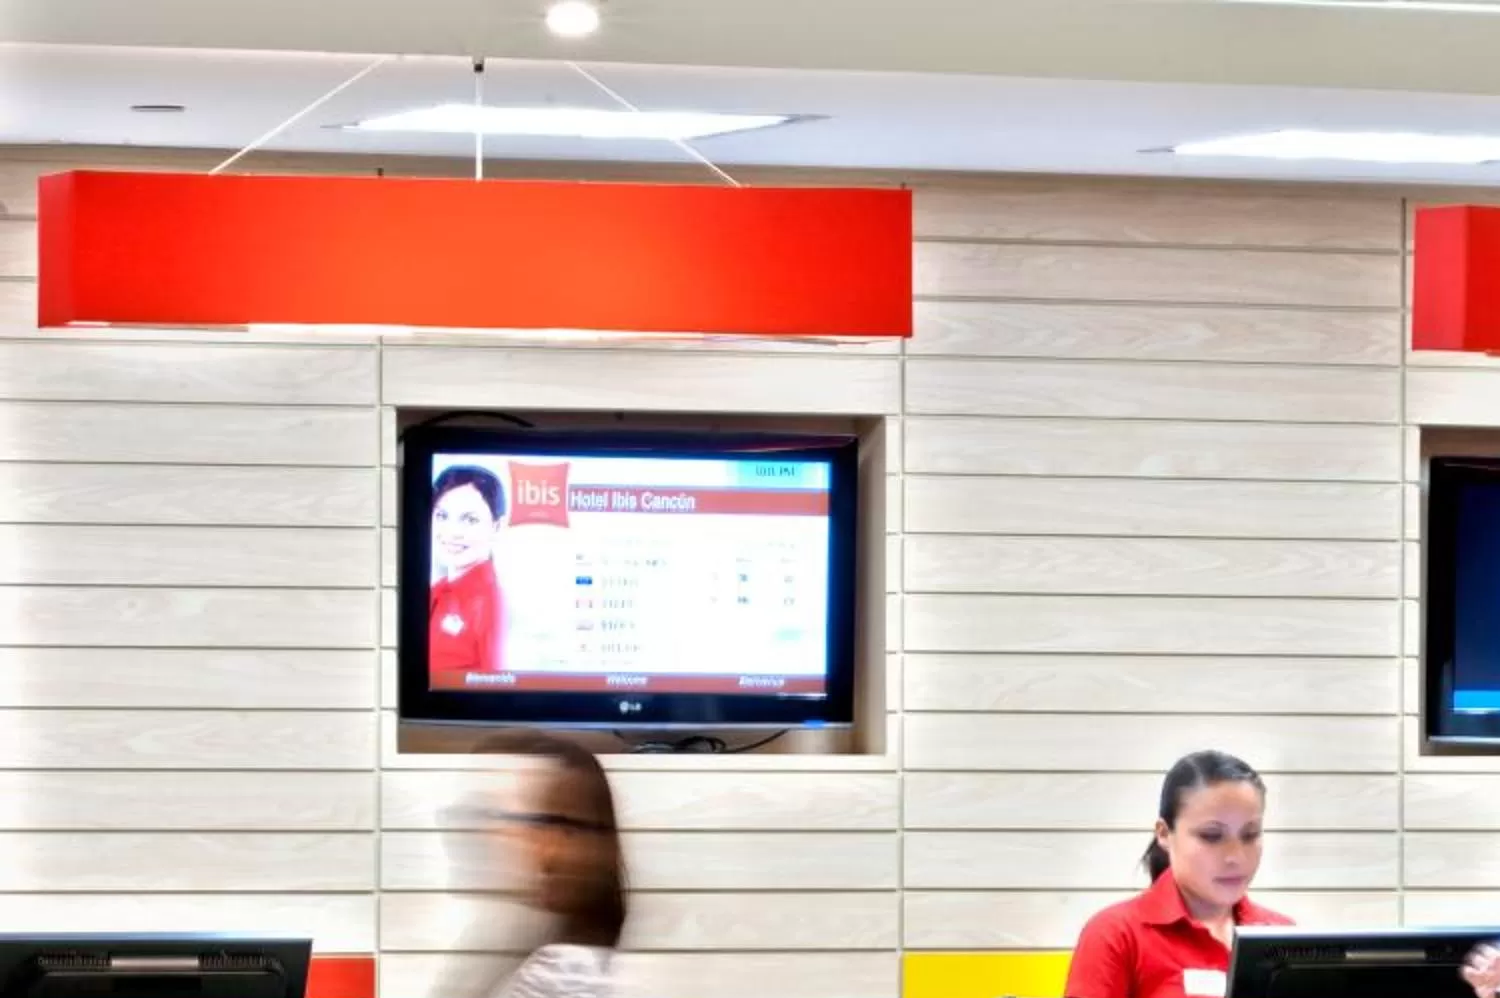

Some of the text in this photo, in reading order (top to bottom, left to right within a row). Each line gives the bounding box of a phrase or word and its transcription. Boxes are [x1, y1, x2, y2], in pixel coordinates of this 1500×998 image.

[517, 479, 561, 507] ibis
[570, 490, 697, 510] Hotel Ibis Cancún
